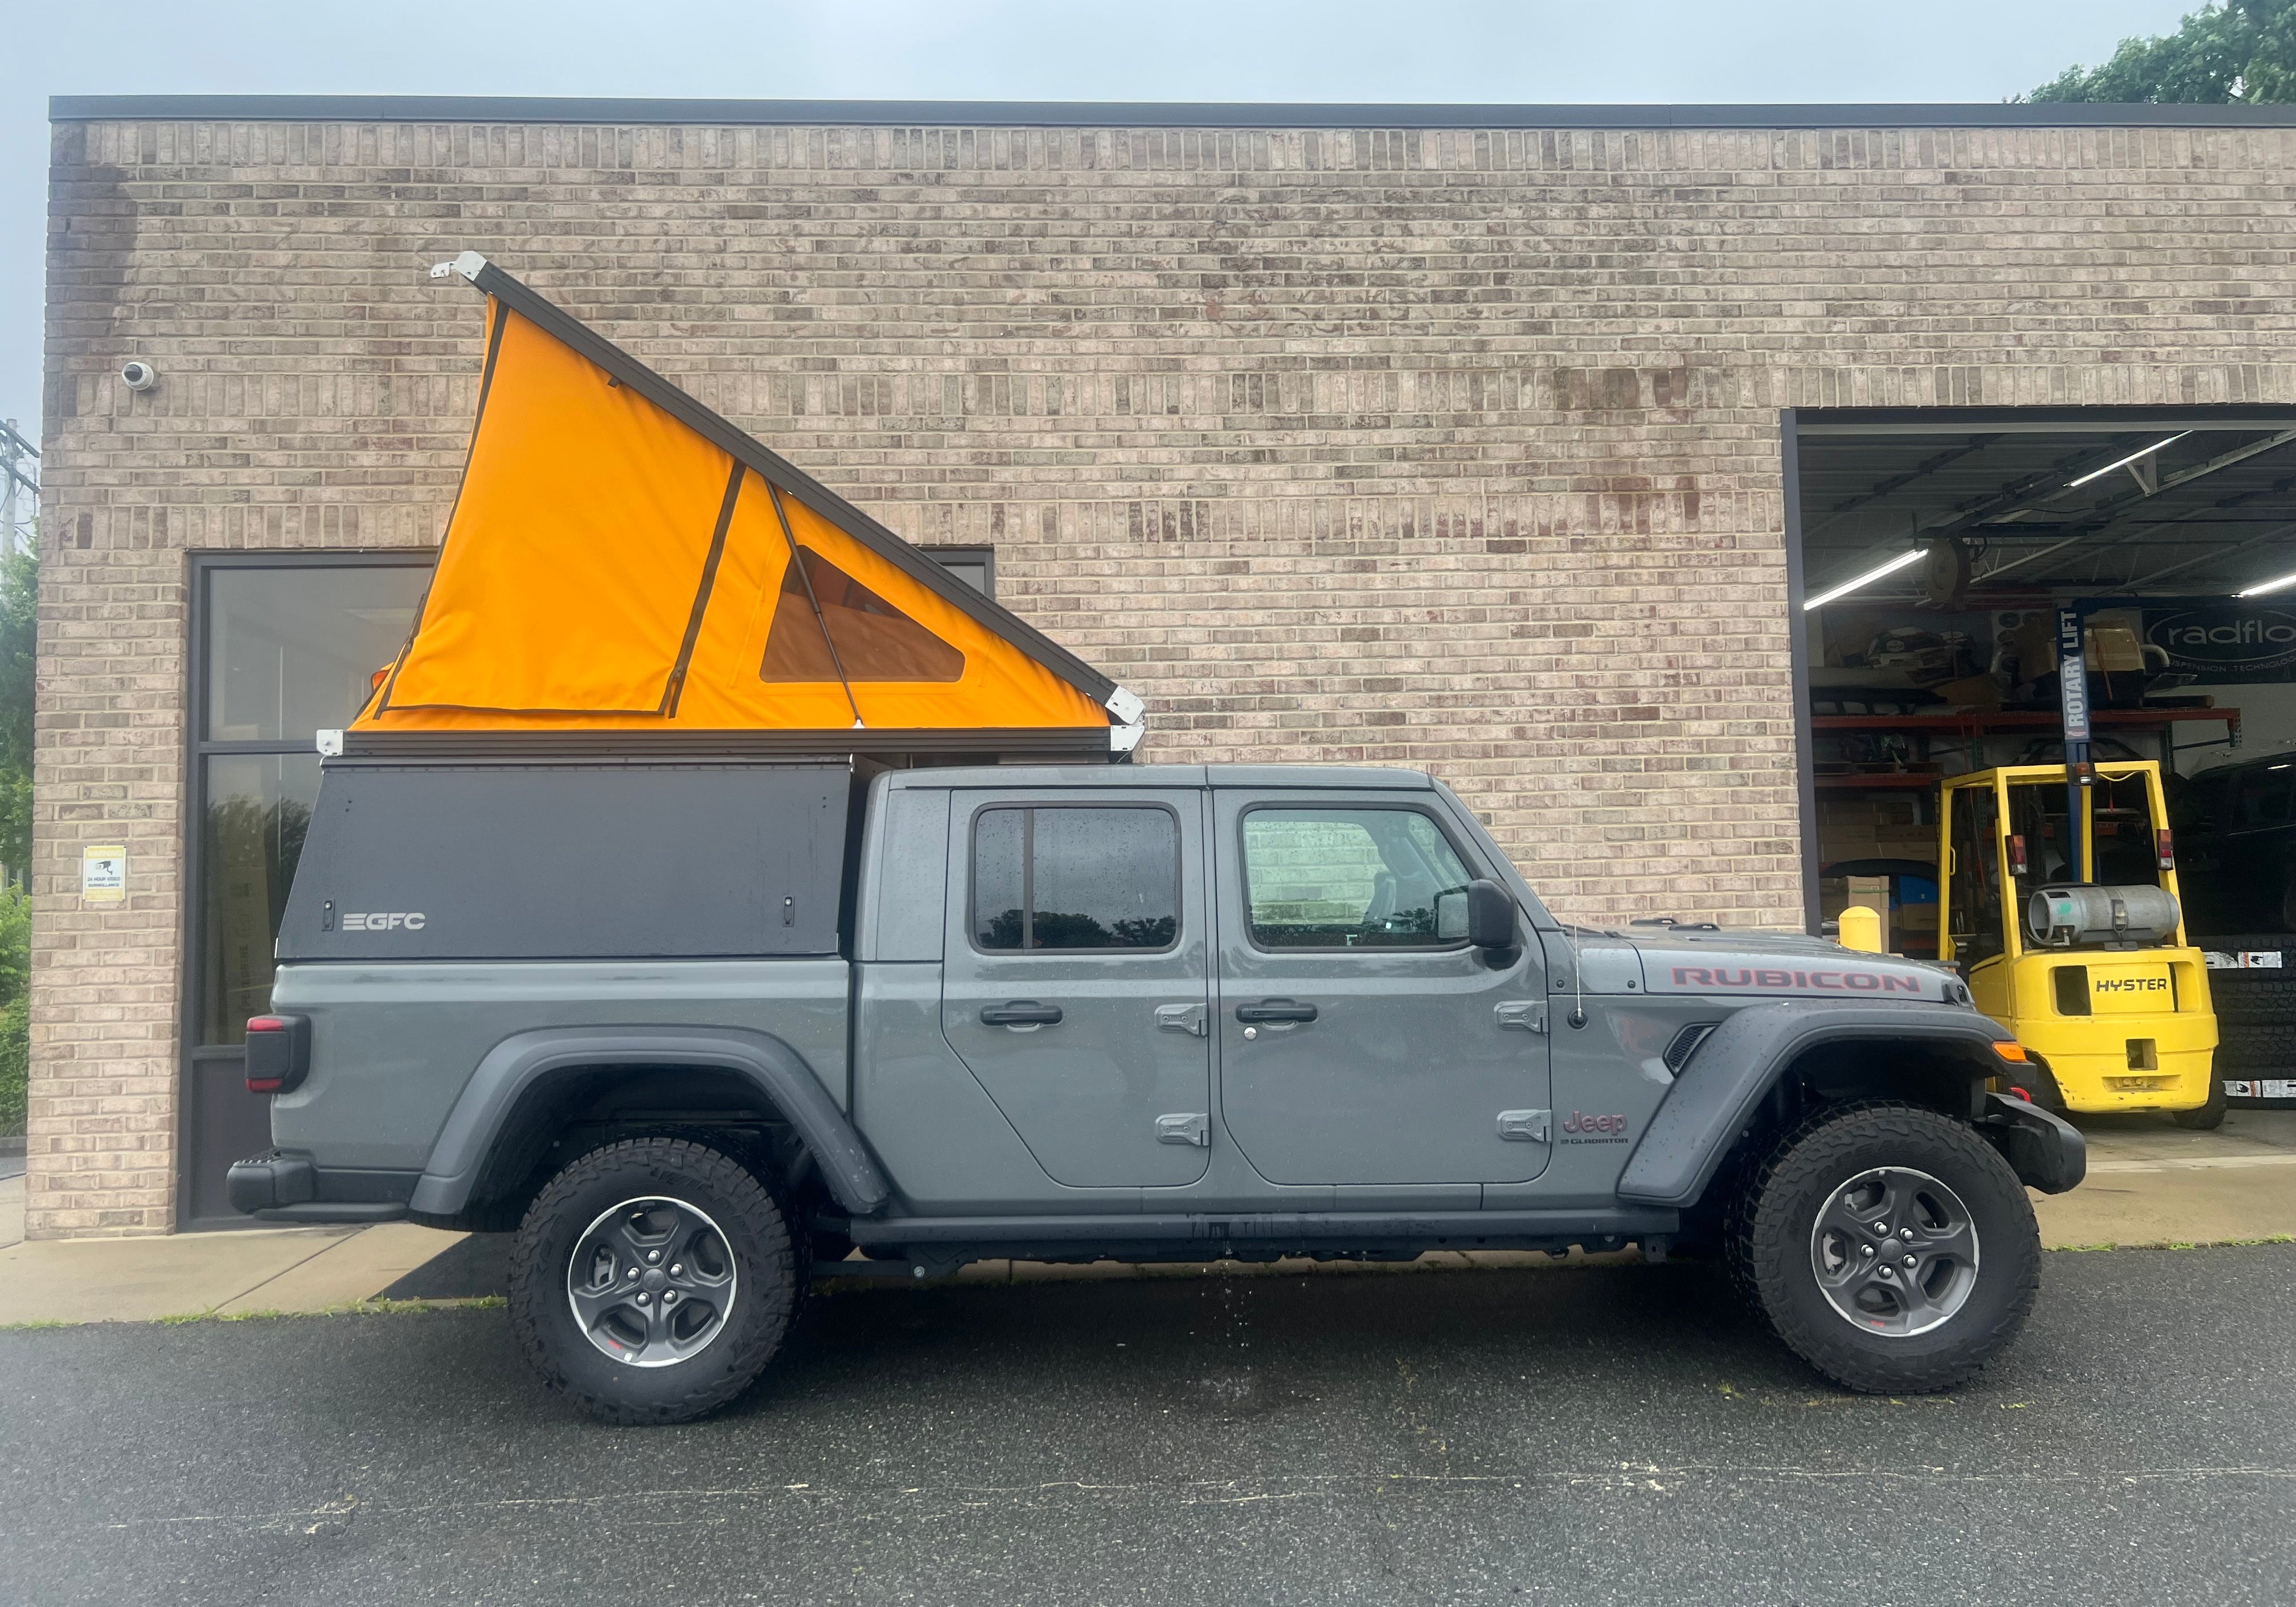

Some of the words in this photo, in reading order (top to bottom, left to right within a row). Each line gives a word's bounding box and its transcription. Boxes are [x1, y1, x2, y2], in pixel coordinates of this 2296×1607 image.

[2060, 611, 2078, 649] LIFT
[2168, 620, 2296, 645] radflo
[2169, 659, 2227, 673] USPENSION
[2233, 655, 2296, 671] TECHNOLOG
[2063, 654, 2084, 727] ROTARY
[1672, 967, 1921, 993] RUBICON
[2096, 978, 2167, 992] HYSTER
[1563, 1111, 1627, 1135] Jeep
